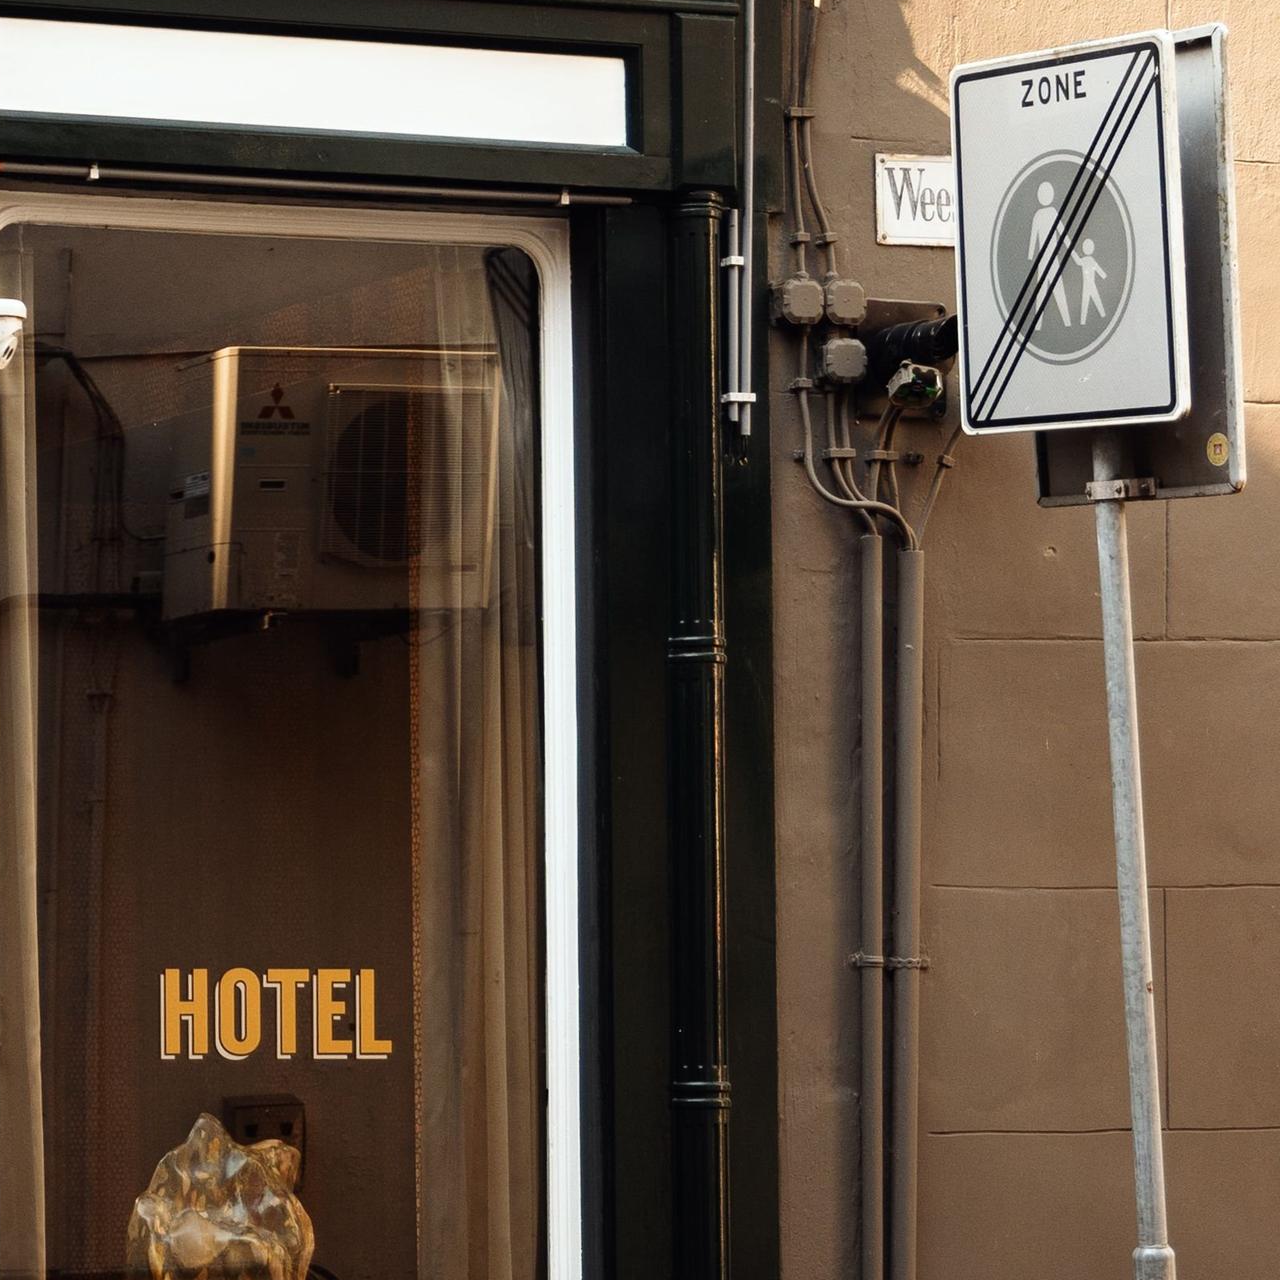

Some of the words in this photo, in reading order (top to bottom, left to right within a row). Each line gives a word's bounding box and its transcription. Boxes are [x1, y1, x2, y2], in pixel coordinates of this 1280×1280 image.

[1020, 69, 1087, 108] ZONE
[884, 167, 955, 223] Wee
[160, 967, 392, 1061] HOTEL
